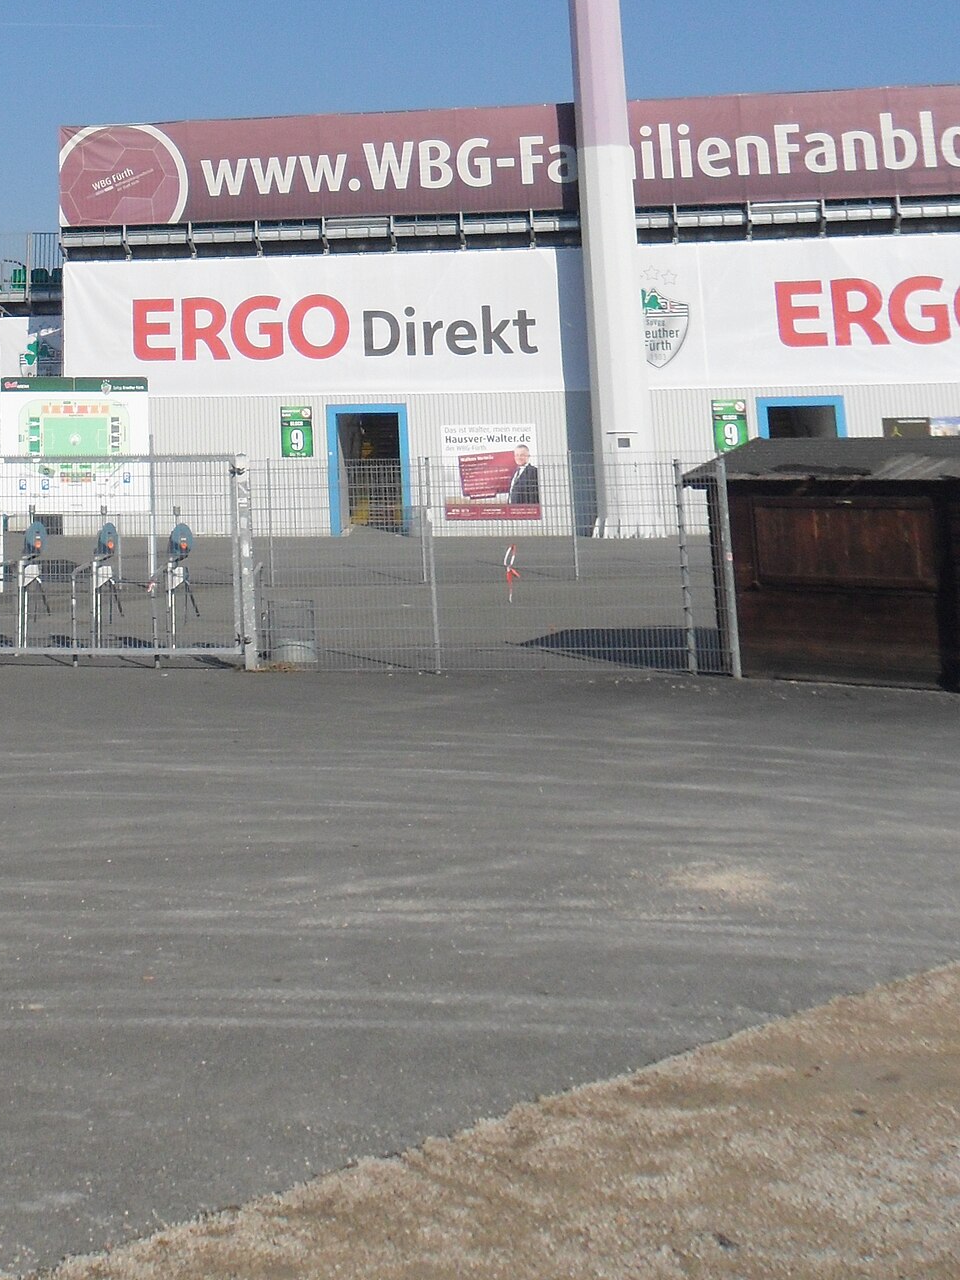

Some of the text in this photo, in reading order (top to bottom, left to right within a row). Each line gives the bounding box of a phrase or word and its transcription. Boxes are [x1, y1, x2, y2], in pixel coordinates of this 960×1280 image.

[92, 176, 112, 191] WBG
[112, 167, 134, 183] Fürth
[774, 275, 960, 347] ERG
[132, 293, 539, 361] ERGO Direkt
[645, 328, 680, 339] euther
[291, 429, 304, 451] 9
[445, 433, 531, 443] Hausver-Walter.de
[724, 423, 738, 446] 9
